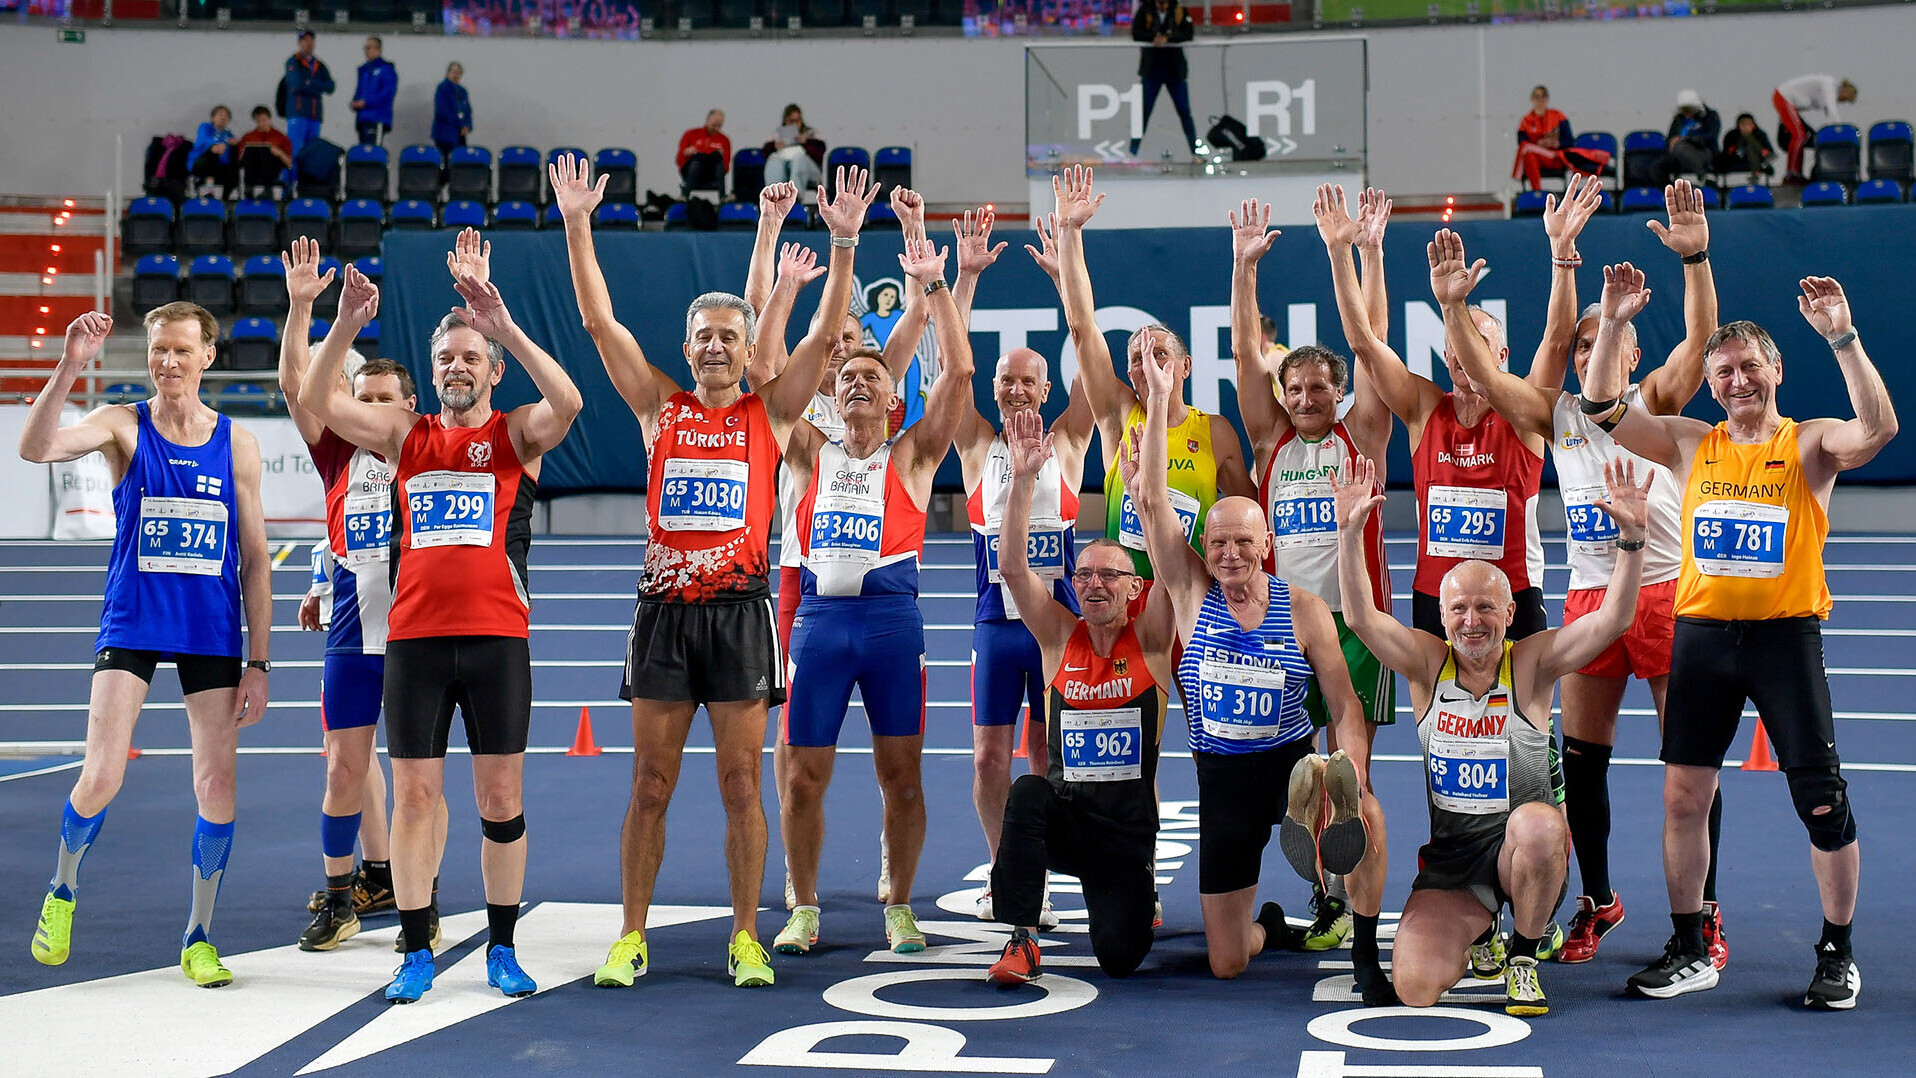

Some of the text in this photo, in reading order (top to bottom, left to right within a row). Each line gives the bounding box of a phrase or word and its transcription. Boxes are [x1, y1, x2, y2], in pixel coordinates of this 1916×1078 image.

[1077, 84, 1144, 140] P1
[1246, 79, 1316, 137] R1
[676, 428, 746, 448] TÜRKİYE
[168, 458, 192, 467] CRAFT
[1438, 451, 1495, 468] DANMARK
[366, 469, 390, 481] GRE
[836, 470, 869, 482] GREAT
[1280, 465, 1340, 482] HUNGARY
[665, 480, 743, 510] 65 3030
[830, 480, 870, 495] BRITAIN
[1700, 480, 1786, 498] GERMANY
[410, 494, 434, 512] 65
[444, 494, 485, 520] 299
[670, 497, 680, 507] M
[1275, 502, 1295, 518] 65
[348, 516, 371, 531] 65
[416, 512, 427, 524] M
[1124, 514, 1134, 525] M
[1280, 518, 1290, 528] M
[1431, 508, 1496, 536] 65 295
[1569, 508, 1588, 523] 65
[144, 520, 217, 550] 65 374
[814, 514, 879, 542] 65 3406
[816, 530, 824, 541] M
[1436, 524, 1445, 534] M
[1697, 520, 1773, 552] 65 781
[150, 537, 161, 548] M
[355, 532, 365, 542] M
[1703, 538, 1715, 550] M
[1204, 646, 1282, 670] ESTONIA
[1064, 677, 1133, 700] GERMANY
[1203, 684, 1273, 717] 65 310
[1208, 702, 1217, 712] M
[1436, 710, 1507, 738] GERMANY
[1065, 731, 1132, 757] 65 962
[1071, 749, 1080, 759] M
[1430, 758, 1498, 789] 65 804
[1435, 775, 1443, 786] M
